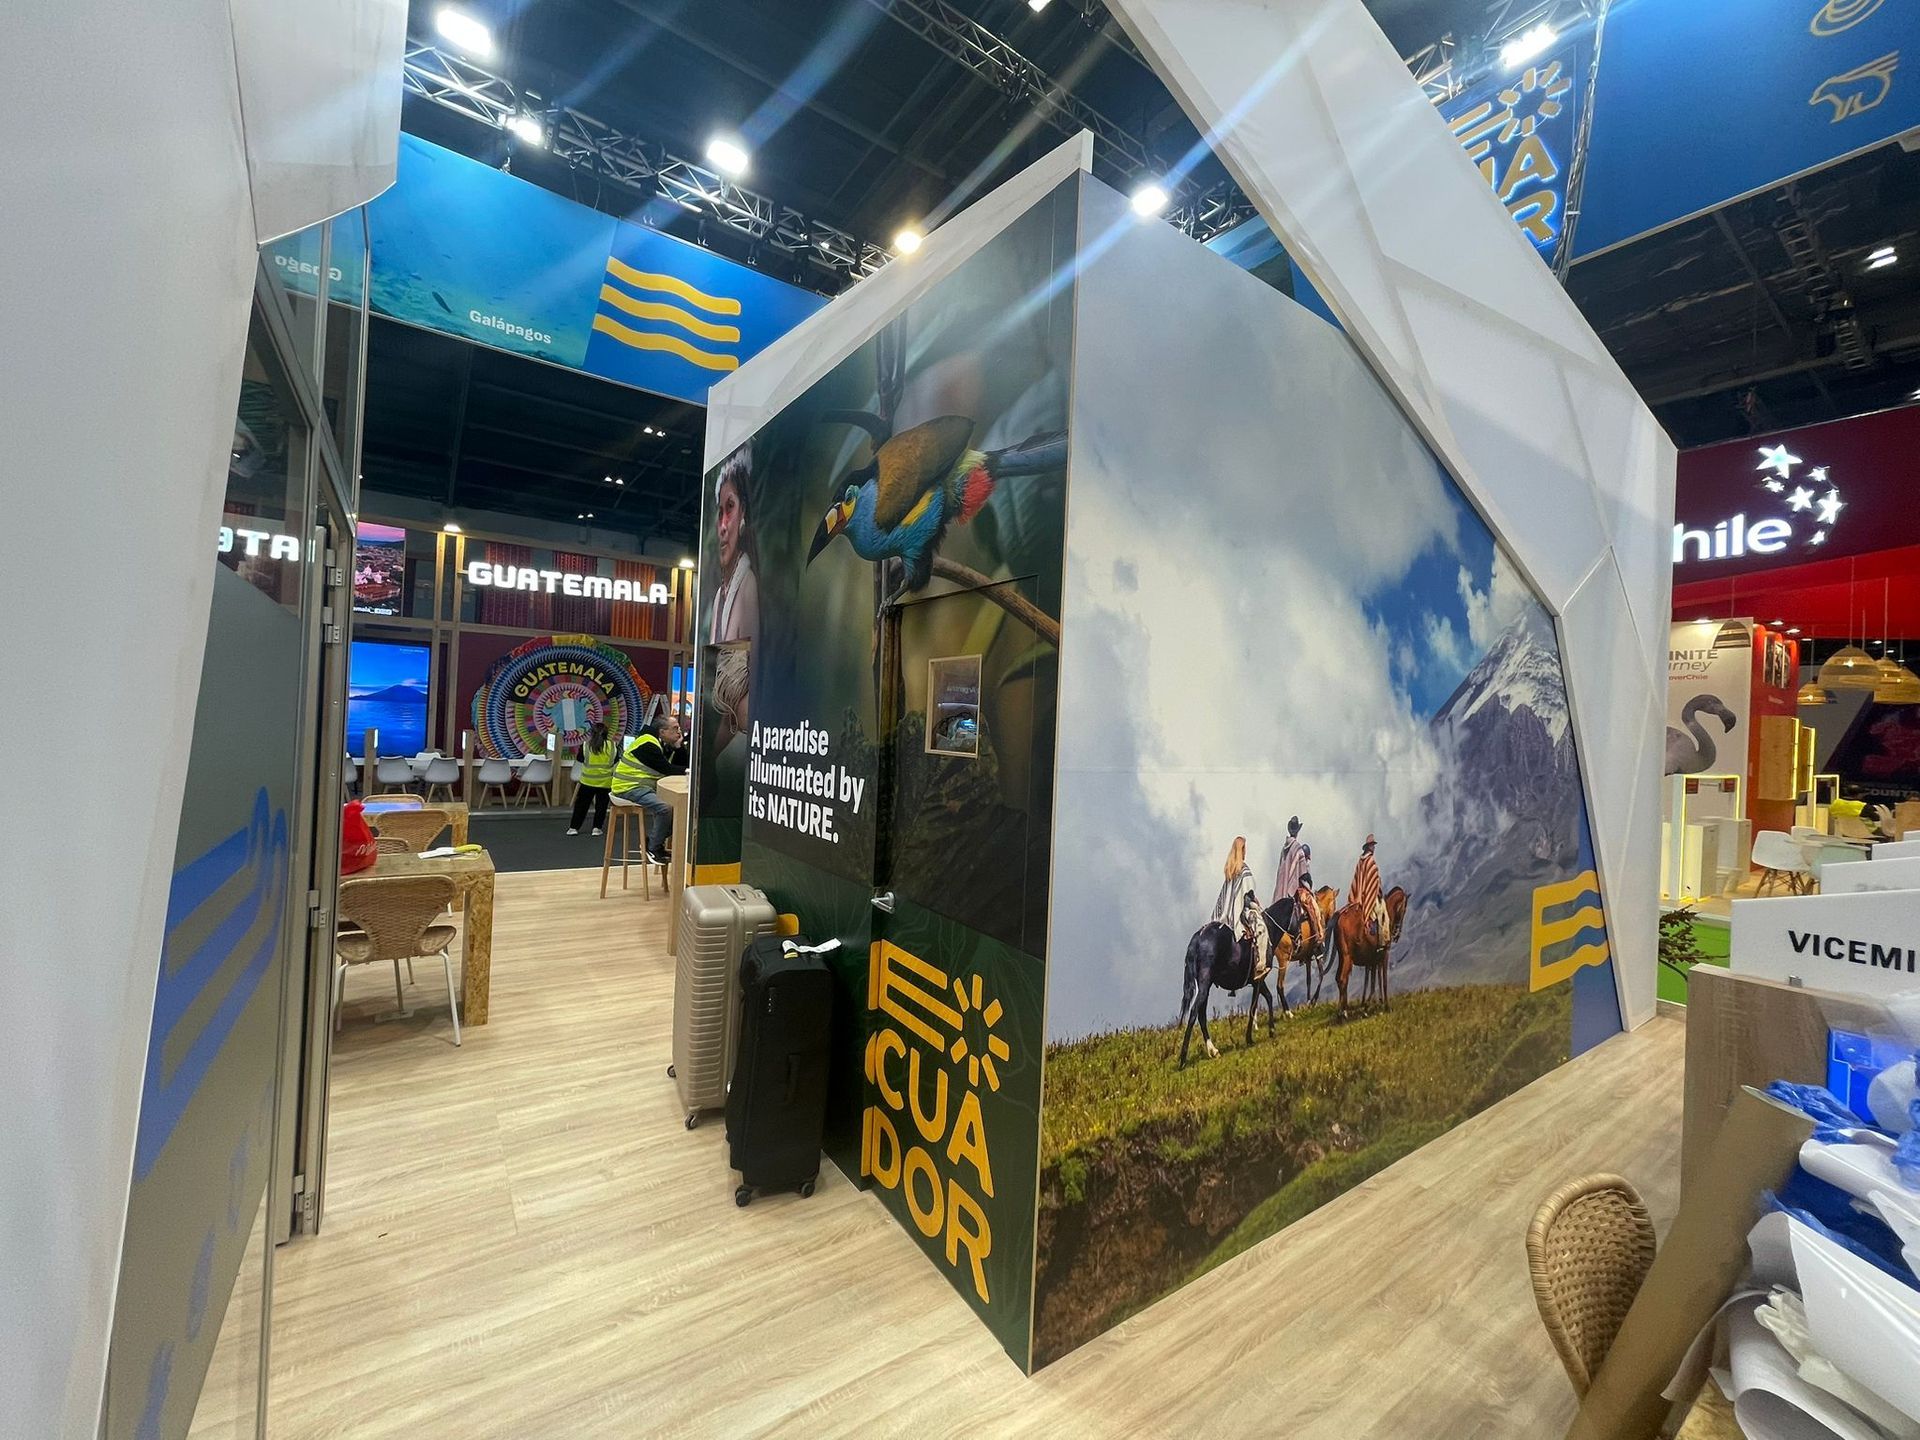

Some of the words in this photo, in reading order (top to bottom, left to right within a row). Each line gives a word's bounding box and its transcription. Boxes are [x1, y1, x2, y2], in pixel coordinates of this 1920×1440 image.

[469, 310, 552, 344] Galápagos
[1672, 513, 1793, 563] hile
[467, 561, 668, 605] GUATEMALA
[1668, 661, 1712, 673] rney
[1669, 649, 1719, 661] INITE
[514, 661, 617, 698] GUATEMALA
[750, 720, 761, 748] A
[762, 719, 830, 756] paradise
[749, 751, 836, 800] illuminated
[839, 765, 865, 815] by
[748, 785, 766, 820] its
[767, 792, 839, 844] NATURE.
[1787, 929, 1916, 973] VICEMI
